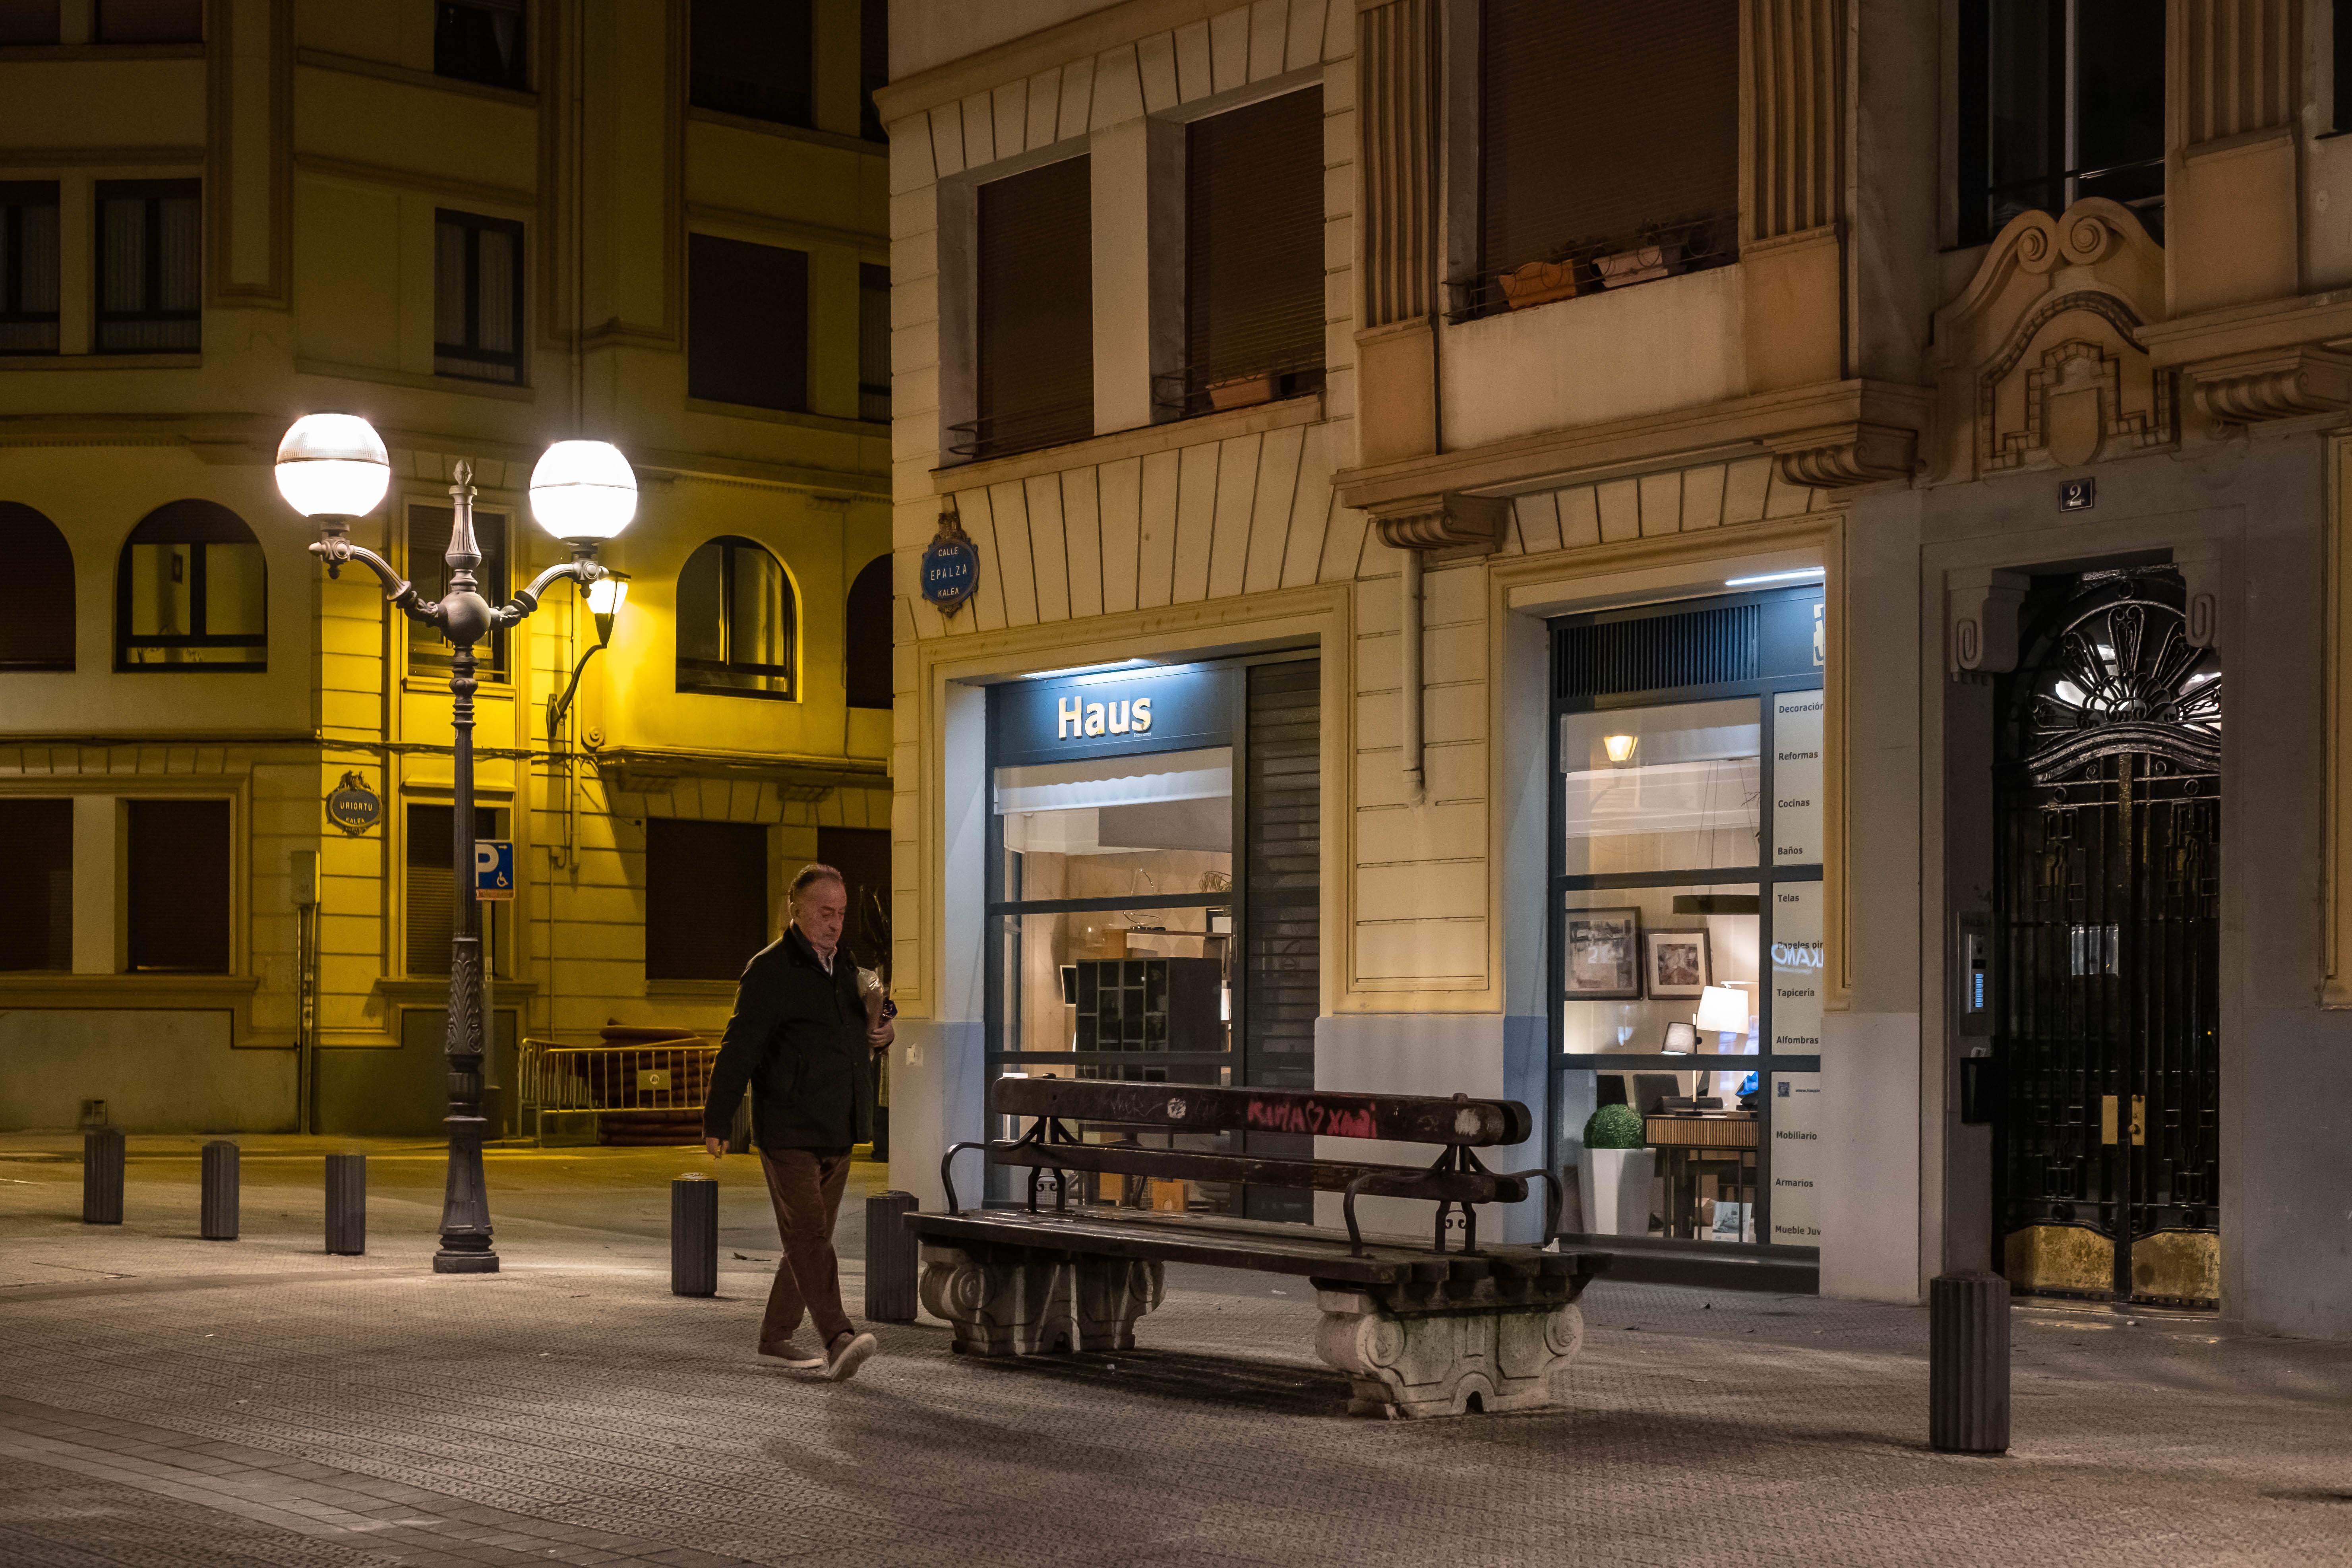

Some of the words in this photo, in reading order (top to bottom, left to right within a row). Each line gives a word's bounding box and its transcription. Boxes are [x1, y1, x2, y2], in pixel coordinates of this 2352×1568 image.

[2069, 484, 2082, 506] 2
[938, 547, 958, 557] CALLE
[931, 563, 967, 581] EPALZA
[938, 587, 959, 597] KALEA
[1058, 696, 1152, 738] Haus
[1778, 751, 1818, 761] Reformas
[340, 801, 372, 811] URIORTU
[1778, 799, 1810, 808] Cocinas
[1777, 846, 1803, 855] Baños
[475, 844, 499, 887] P
[1777, 894, 1799, 902] Telas
[1777, 941, 1810, 950] Papeles
[1777, 987, 1815, 999] Tapicería
[1776, 1036, 1819, 1044] Alfombras
[1776, 1131, 1817, 1140] Mobiliario
[1775, 1178, 1814, 1188] Armarios
[1775, 1225, 1805, 1235] Mueble
